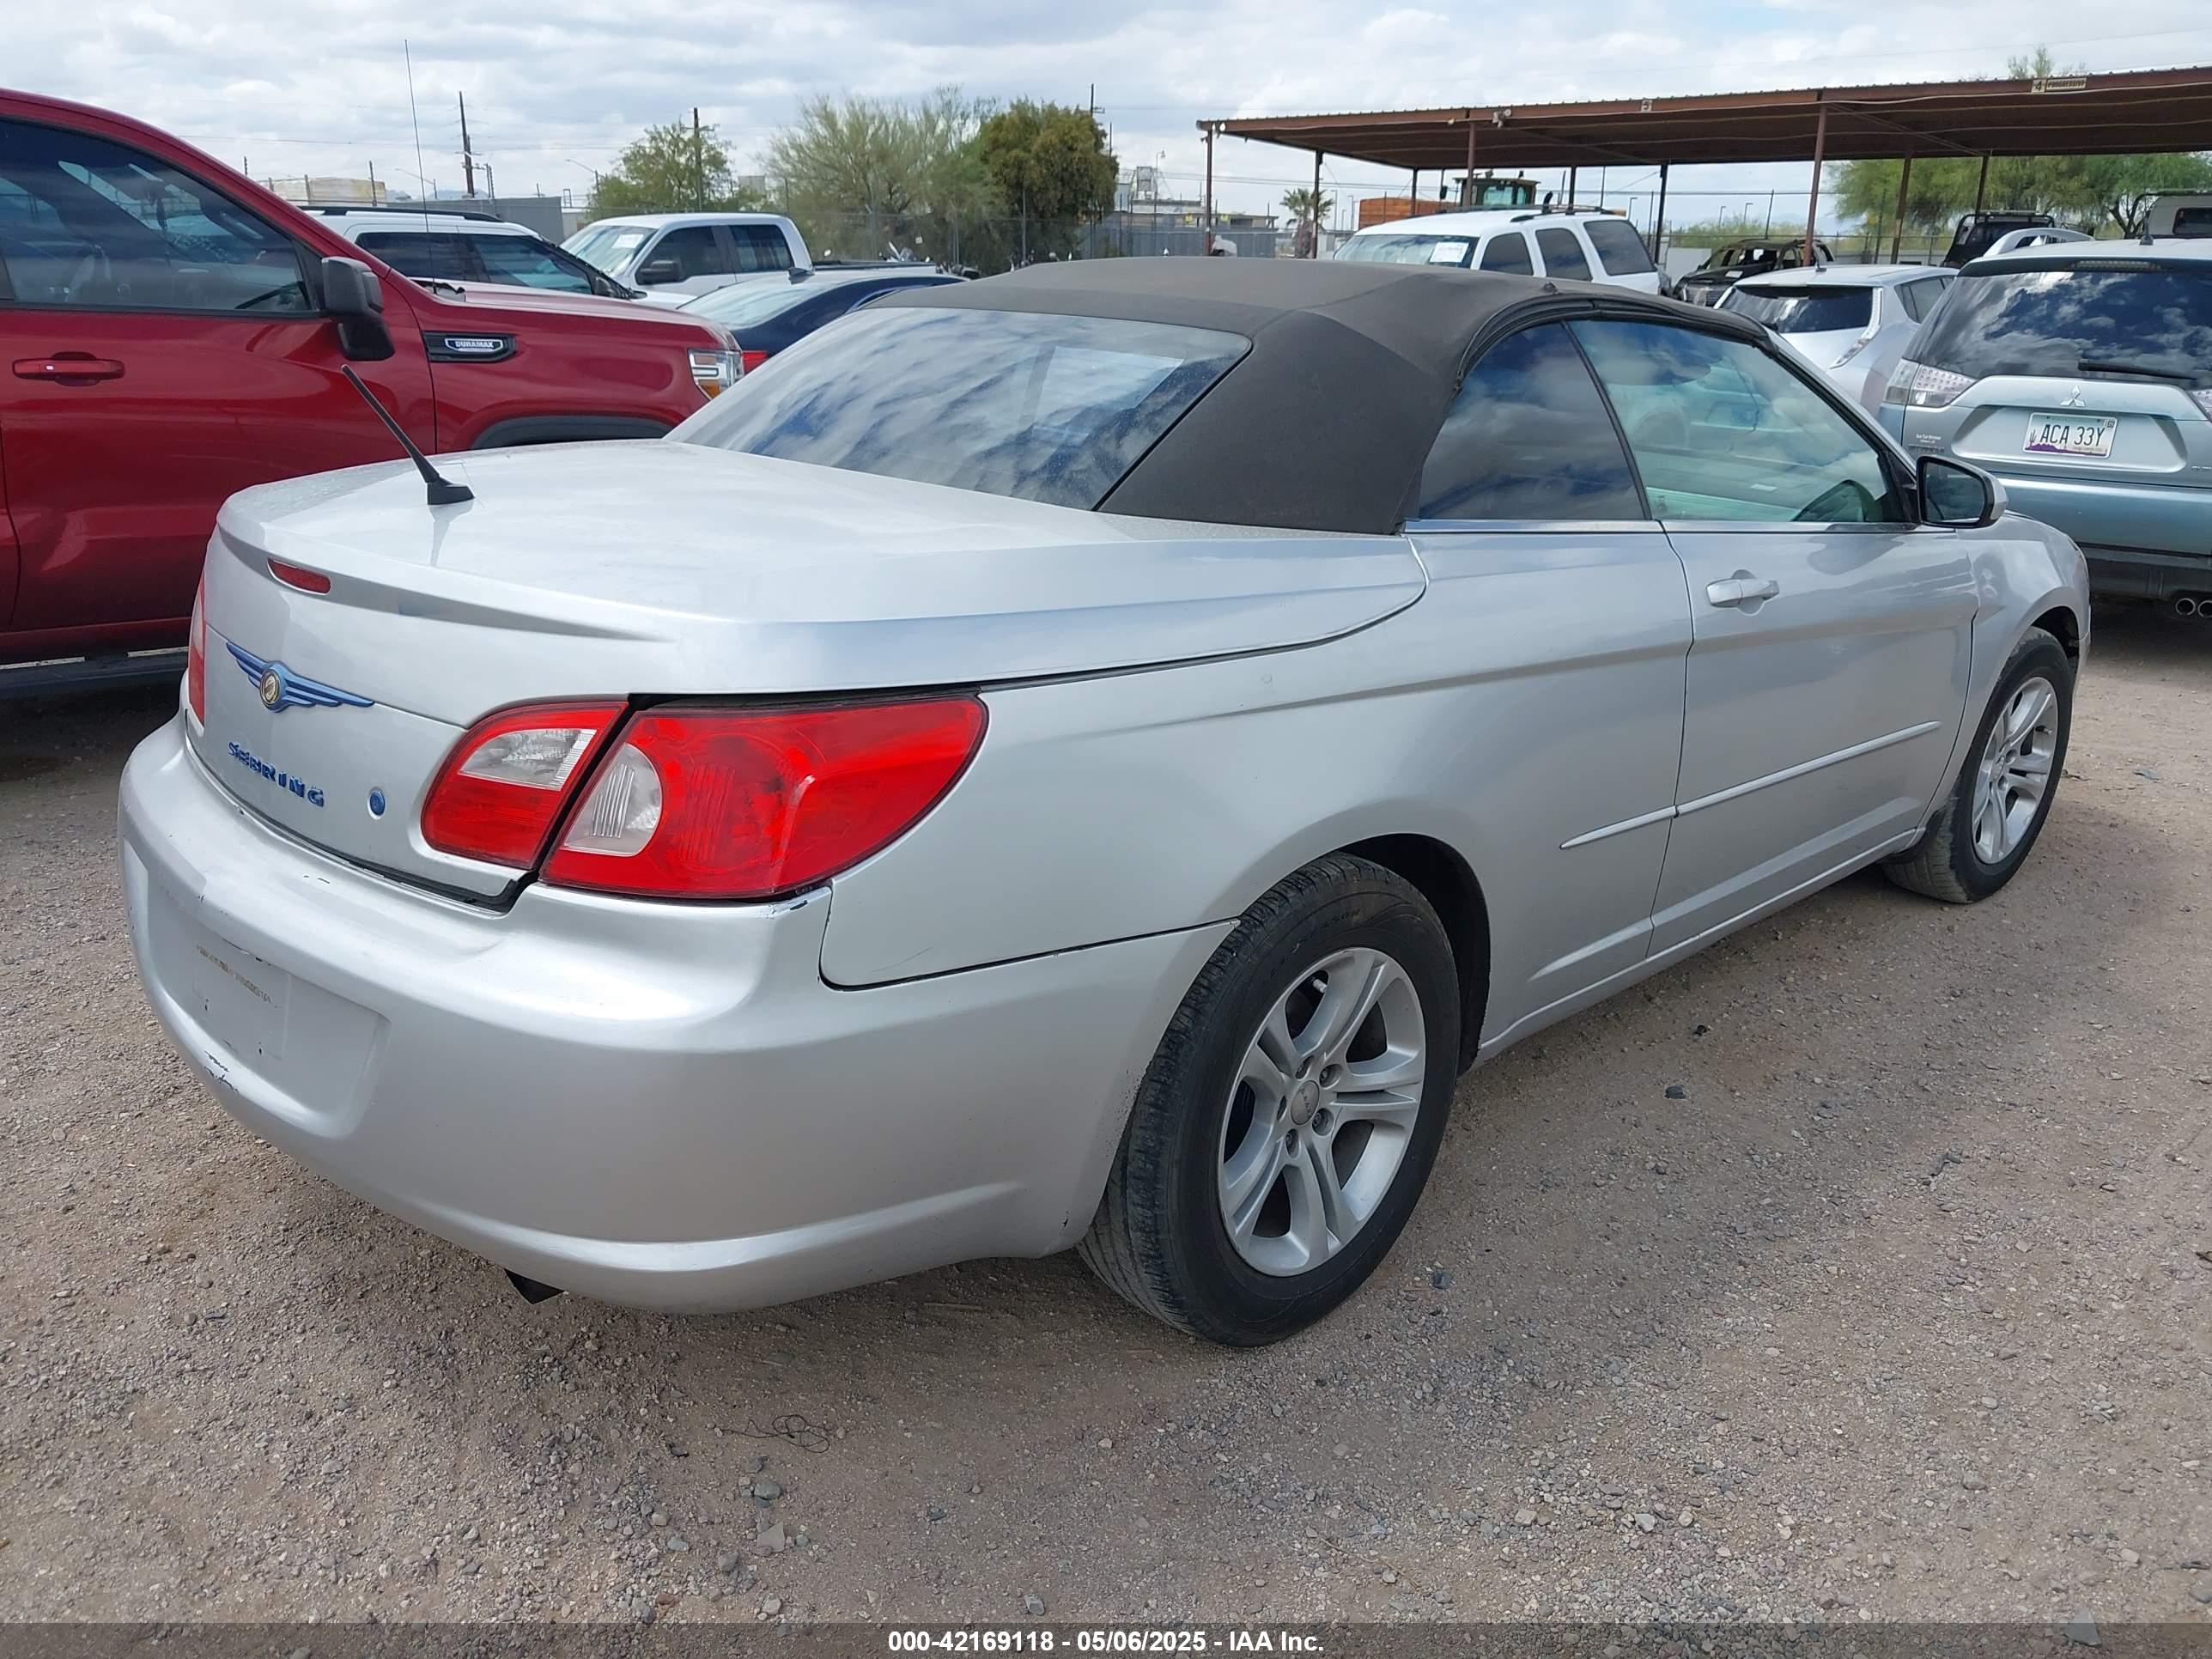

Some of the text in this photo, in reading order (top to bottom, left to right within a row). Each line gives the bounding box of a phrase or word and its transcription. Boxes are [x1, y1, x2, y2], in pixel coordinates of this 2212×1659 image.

[2039, 423, 2070, 445] ACA
[2074, 426, 2106, 447] 33Y
[228, 741, 325, 807] SEBRING
